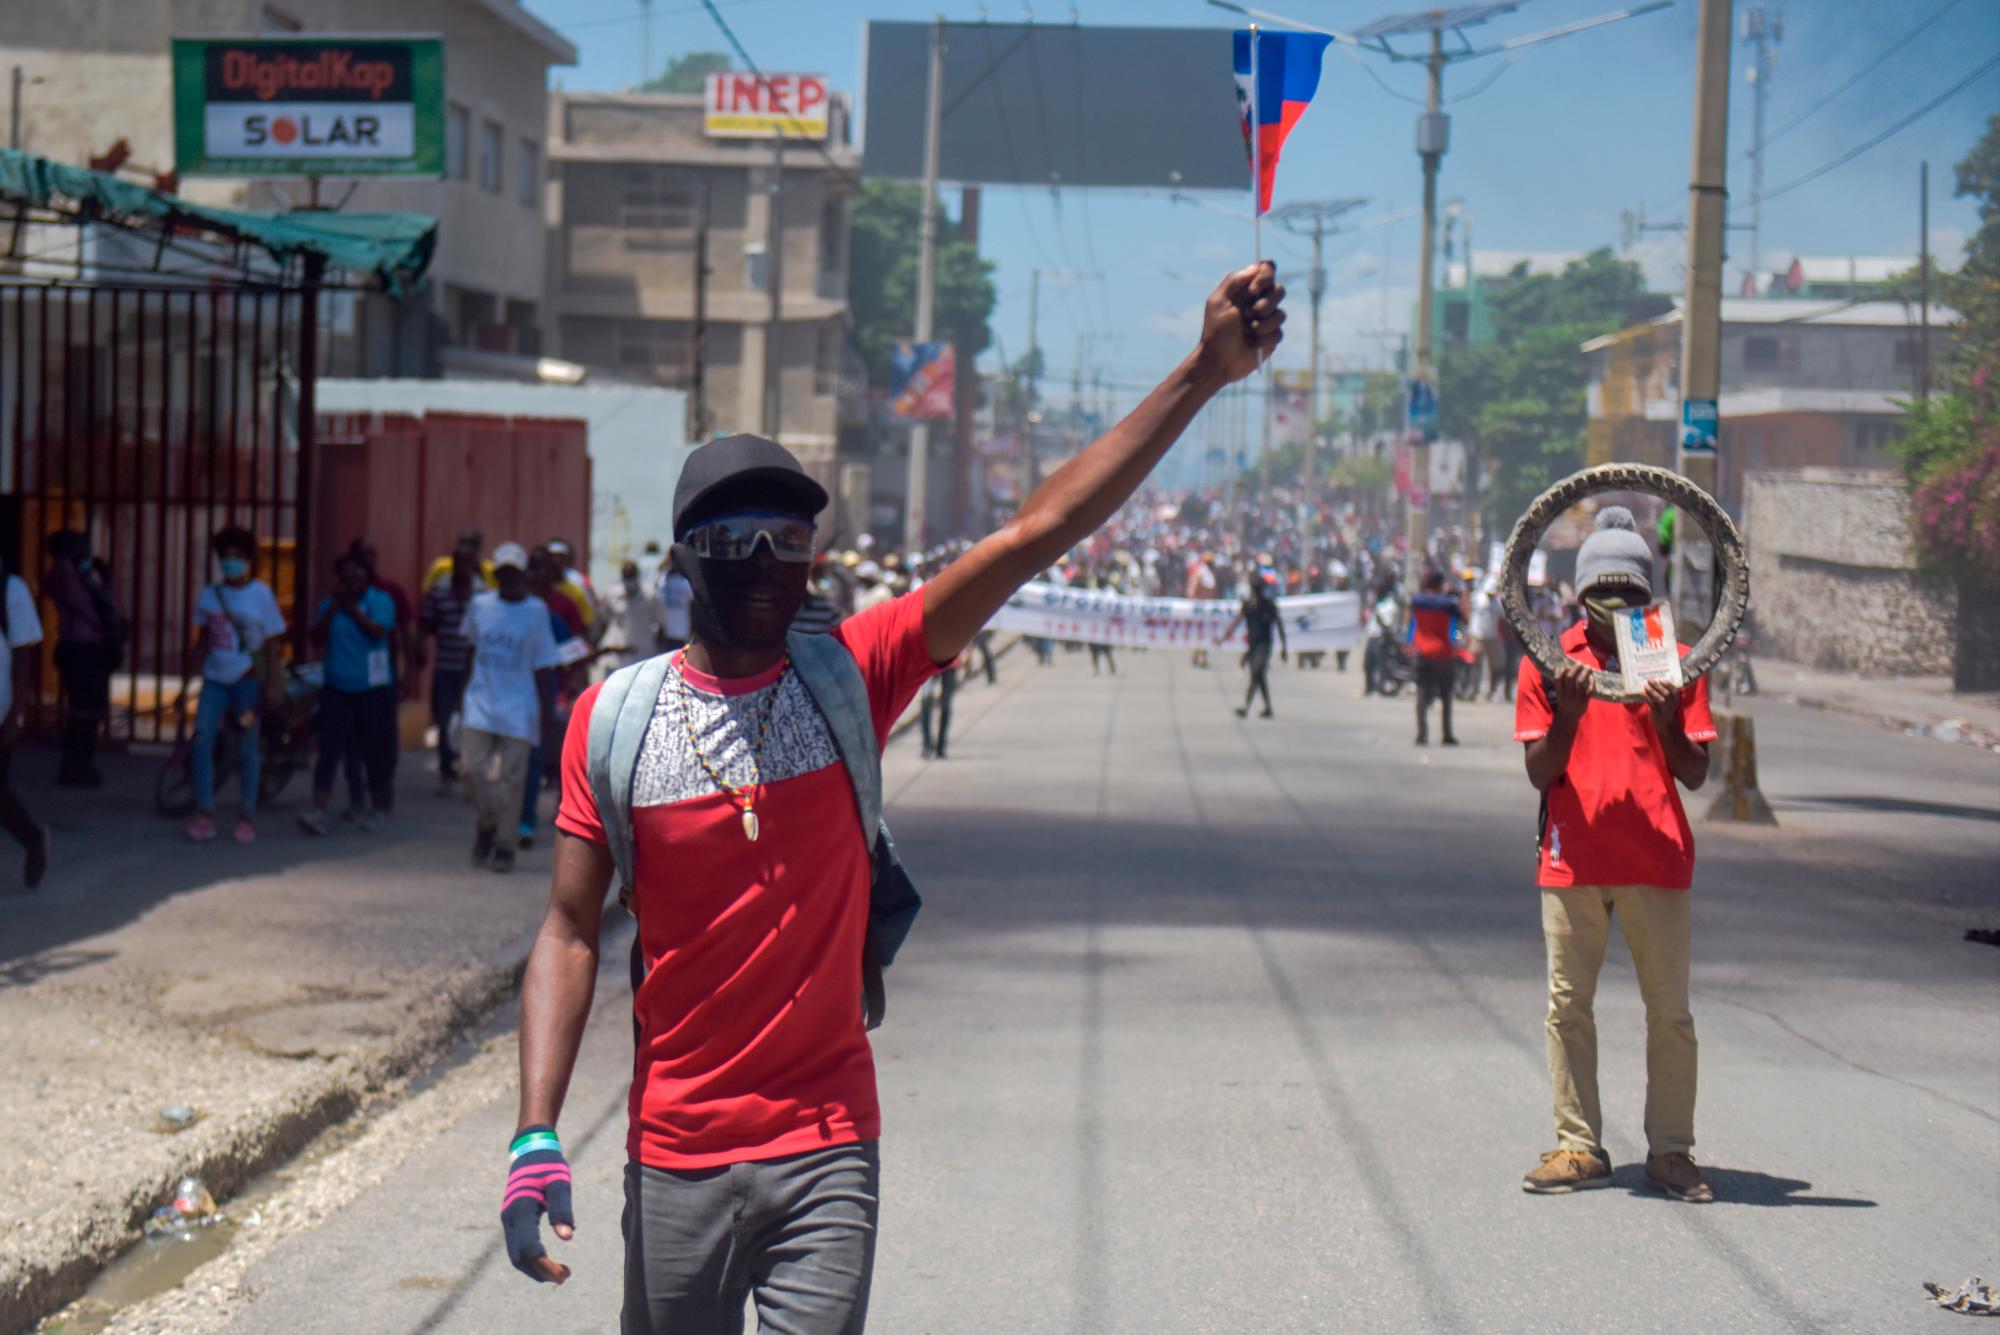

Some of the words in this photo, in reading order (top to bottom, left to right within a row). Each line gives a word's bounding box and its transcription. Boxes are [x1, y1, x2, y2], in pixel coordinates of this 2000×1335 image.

[223, 50, 394, 100] DigitalKap
[715, 75, 826, 113] INEP
[244, 115, 381, 146] SOLAR
